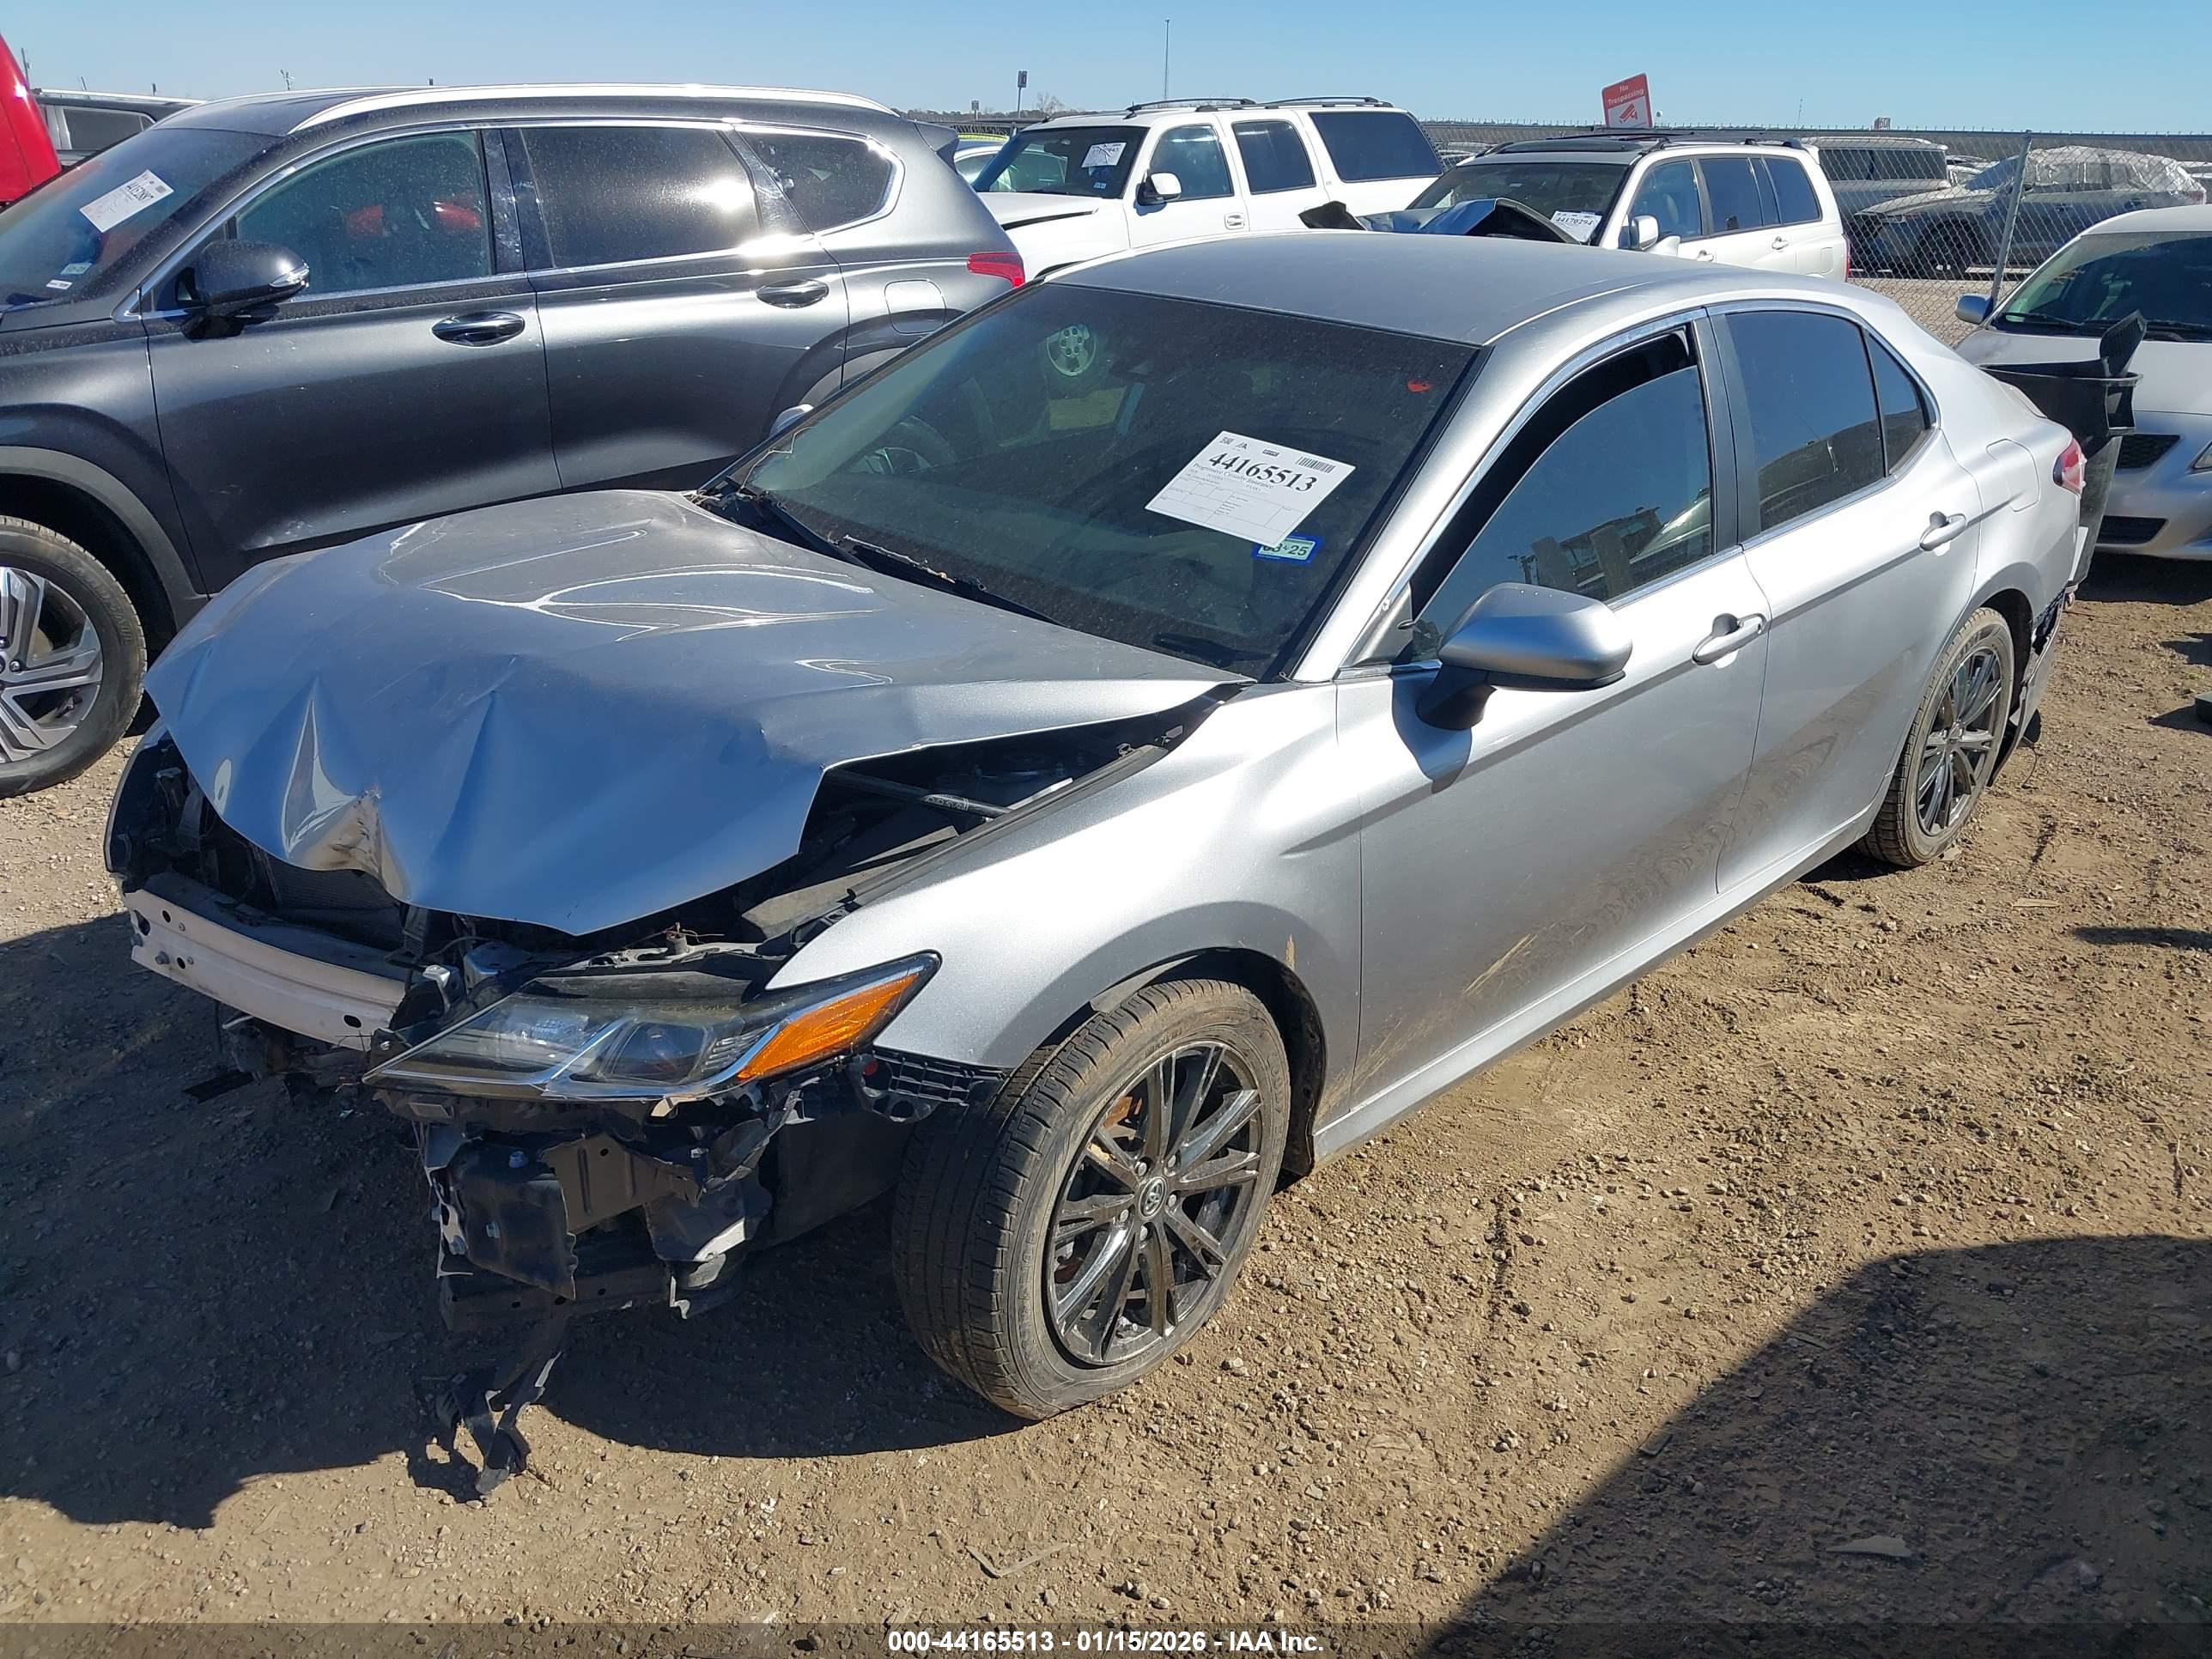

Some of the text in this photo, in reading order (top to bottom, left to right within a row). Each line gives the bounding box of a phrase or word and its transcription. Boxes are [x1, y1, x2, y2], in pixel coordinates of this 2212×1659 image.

[1607, 88, 1644, 106] Trespassing
[1193, 463, 1224, 475] Progressive
[1246, 478, 1273, 489] Insurance
[1209, 453, 1317, 492] 44165513
[1288, 545, 1310, 556] 25
